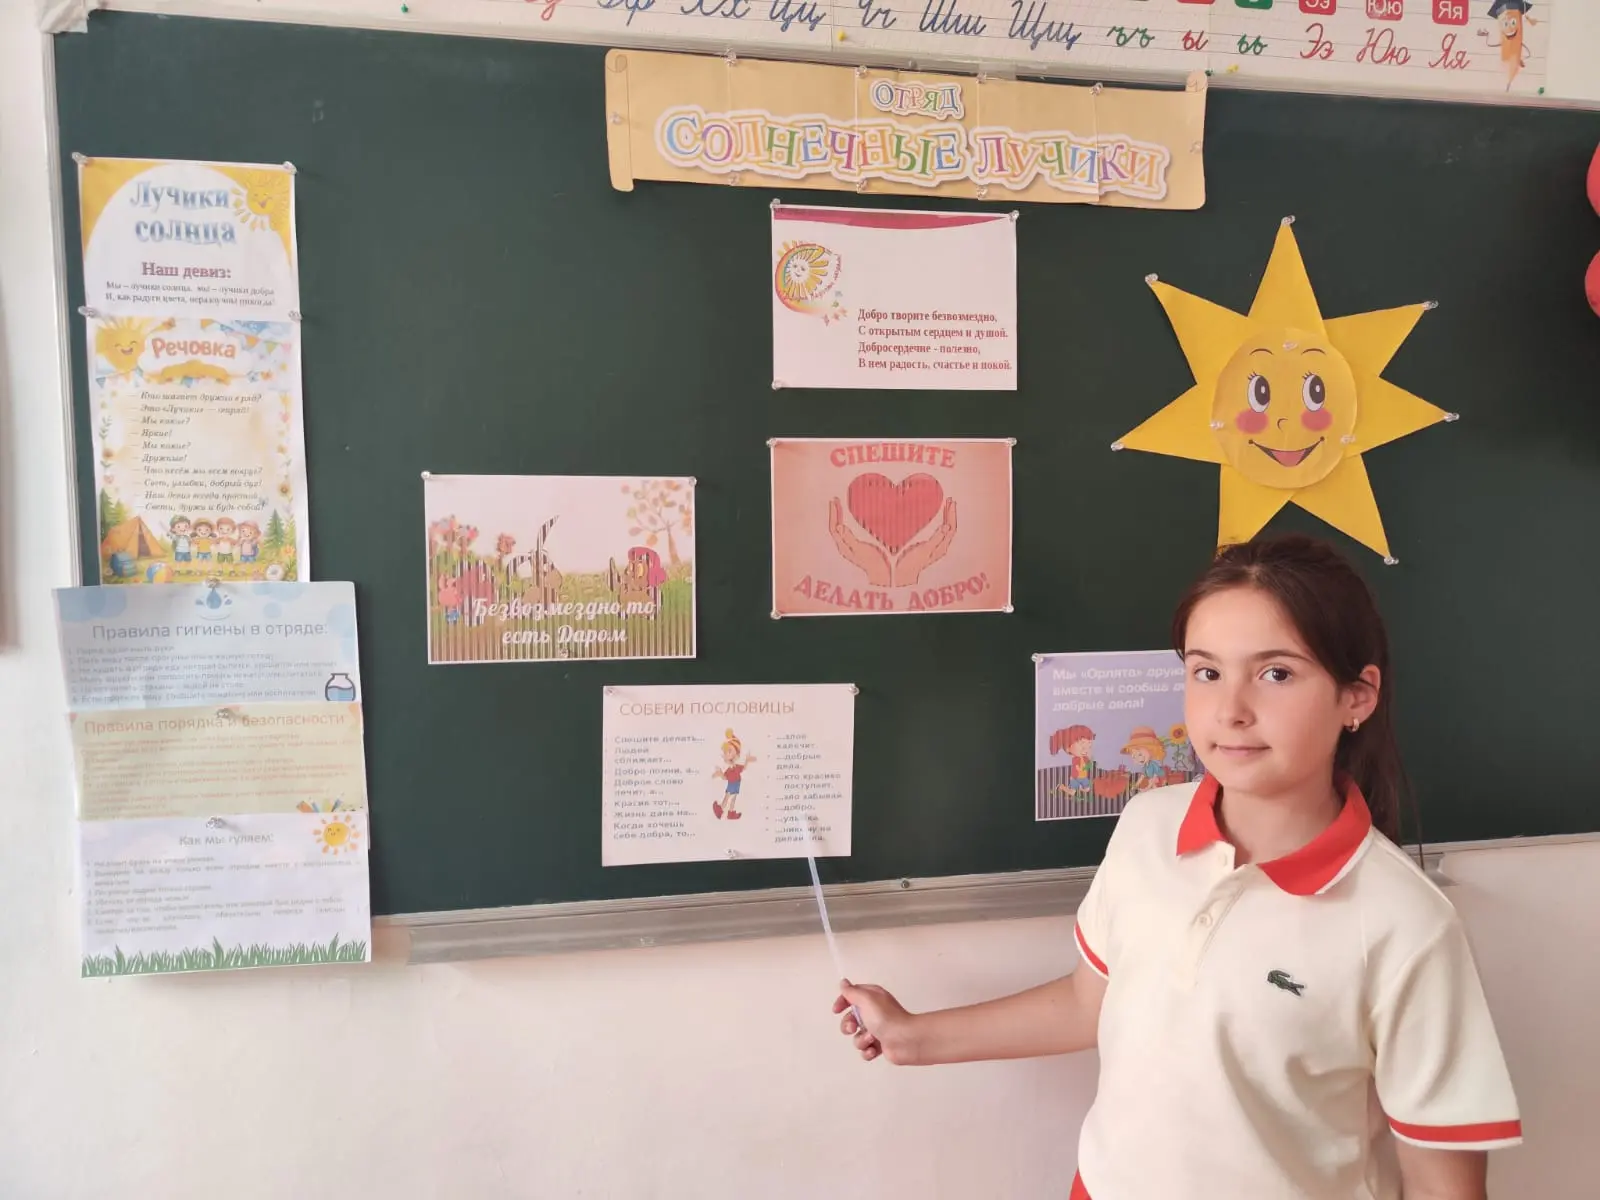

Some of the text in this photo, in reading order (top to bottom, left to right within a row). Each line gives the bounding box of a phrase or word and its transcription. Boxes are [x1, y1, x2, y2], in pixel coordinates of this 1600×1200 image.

[1438, 1, 1463, 20] Яя
[1300, 22, 1334, 60] Ээ
[1356, 27, 1411, 66] Юю
[1428, 32, 1470, 70] Яя
[872, 80, 962, 115] ОТРЯД
[664, 114, 1161, 188] СОЛНЕЧНЫЕ ЛУЧИКИ
[129, 180, 230, 212] Лучики
[134, 219, 237, 247] солнца
[141, 262, 232, 279] Наш девиз:
[857, 307, 998, 324] Добро творите безвозмездно,
[858, 325, 1009, 340] С открытым сердцем и душой.
[151, 337, 236, 359] Речовка
[857, 341, 931, 354] Добросердечие
[939, 343, 981, 355] полезно,
[858, 357, 1013, 371] В нем радость, счастье и покой.
[829, 442, 957, 469] СПЕШИТЕ
[793, 571, 991, 611] ДЕЛАТЬ ДОБРО!
[92, 621, 328, 641] Правила гигиены в отряде:
[502, 624, 628, 648] есть Даром
[1052, 668, 1077, 680] Мы
[1081, 667, 1142, 681] «Орлята»
[1052, 685, 1101, 696] вместе
[1105, 685, 1115, 695] и
[1118, 682, 1169, 694] сообща
[619, 701, 795, 716] СОБЕРИ ПОСЛОВИЦЫ
[1052, 698, 1144, 713] добрые дела!
[84, 720, 154, 736] Правила
[158, 716, 223, 732] порядка
[241, 714, 344, 727] безопасности
[614, 736, 660, 744] Спешите
[614, 768, 646, 776] Добро
[614, 779, 652, 787] Доброе
[613, 822, 644, 830] Когда
[179, 835, 201, 846] Как
